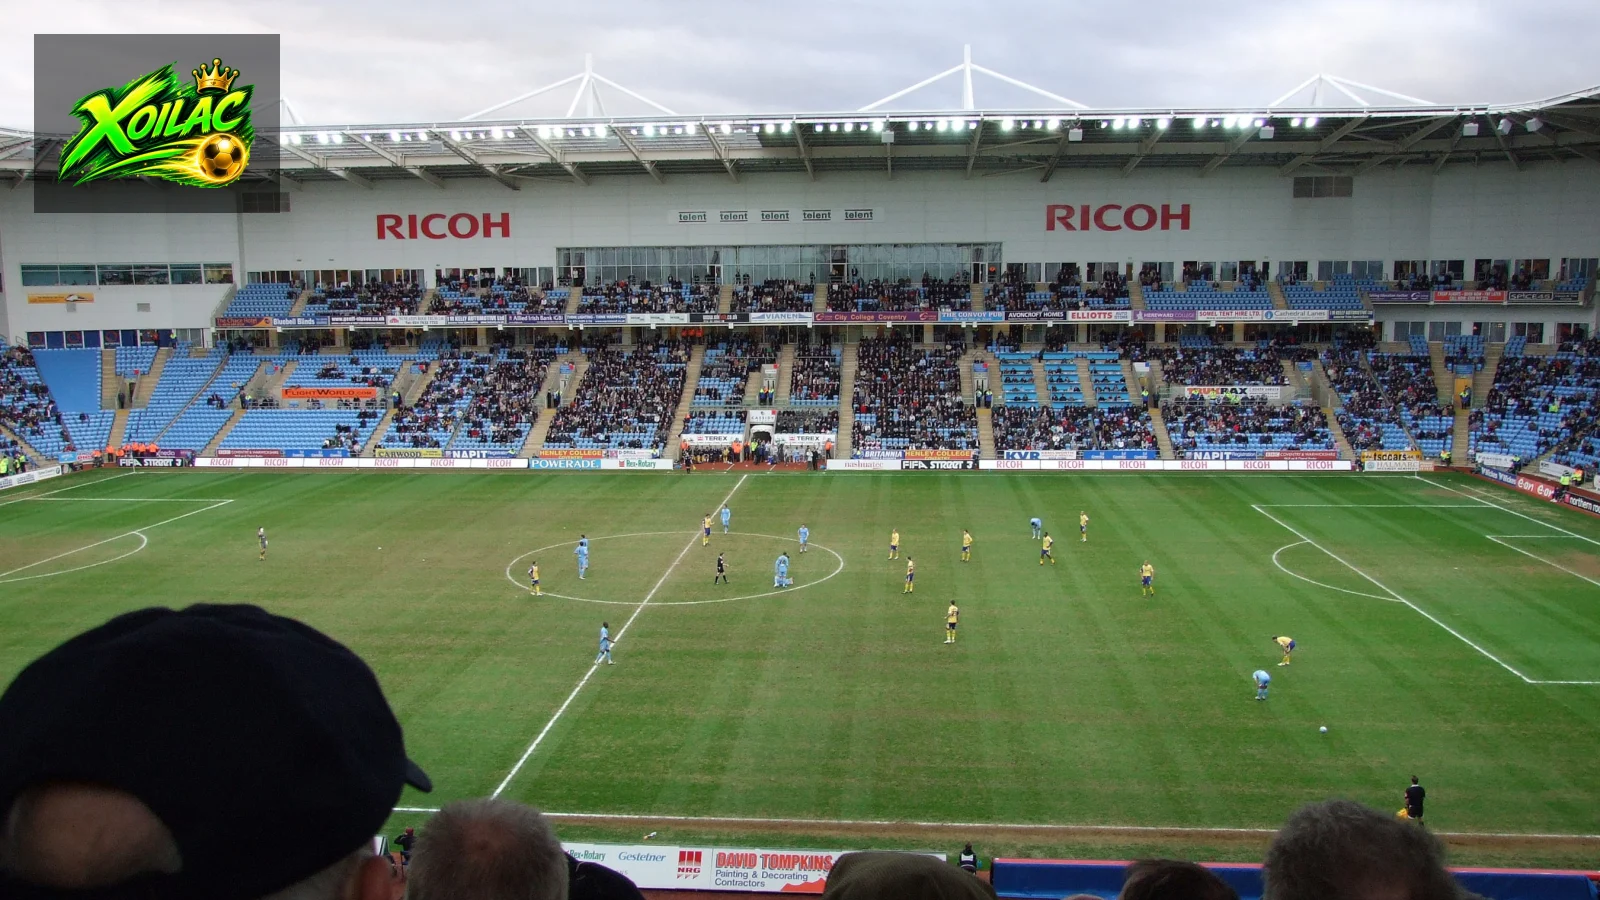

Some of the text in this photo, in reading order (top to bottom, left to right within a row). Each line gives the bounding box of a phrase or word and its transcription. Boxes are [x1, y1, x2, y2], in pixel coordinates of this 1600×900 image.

[679, 213, 706, 221] telent
[720, 212, 748, 220] telent
[761, 212, 790, 220] telent
[803, 211, 831, 219] telent
[845, 210, 873, 219] telent
[1046, 204, 1190, 232] RICOH
[376, 212, 510, 240] RICOH
[903, 461, 972, 469] FIFA STREET 3
[1570, 497, 1592, 510] northern
[618, 851, 666, 862] Gestetner
[716, 852, 833, 872] DAVID TOMPKINS
[716, 870, 748, 880] Painting
[762, 871, 808, 881] Decorating
[715, 878, 765, 887] Contractors
